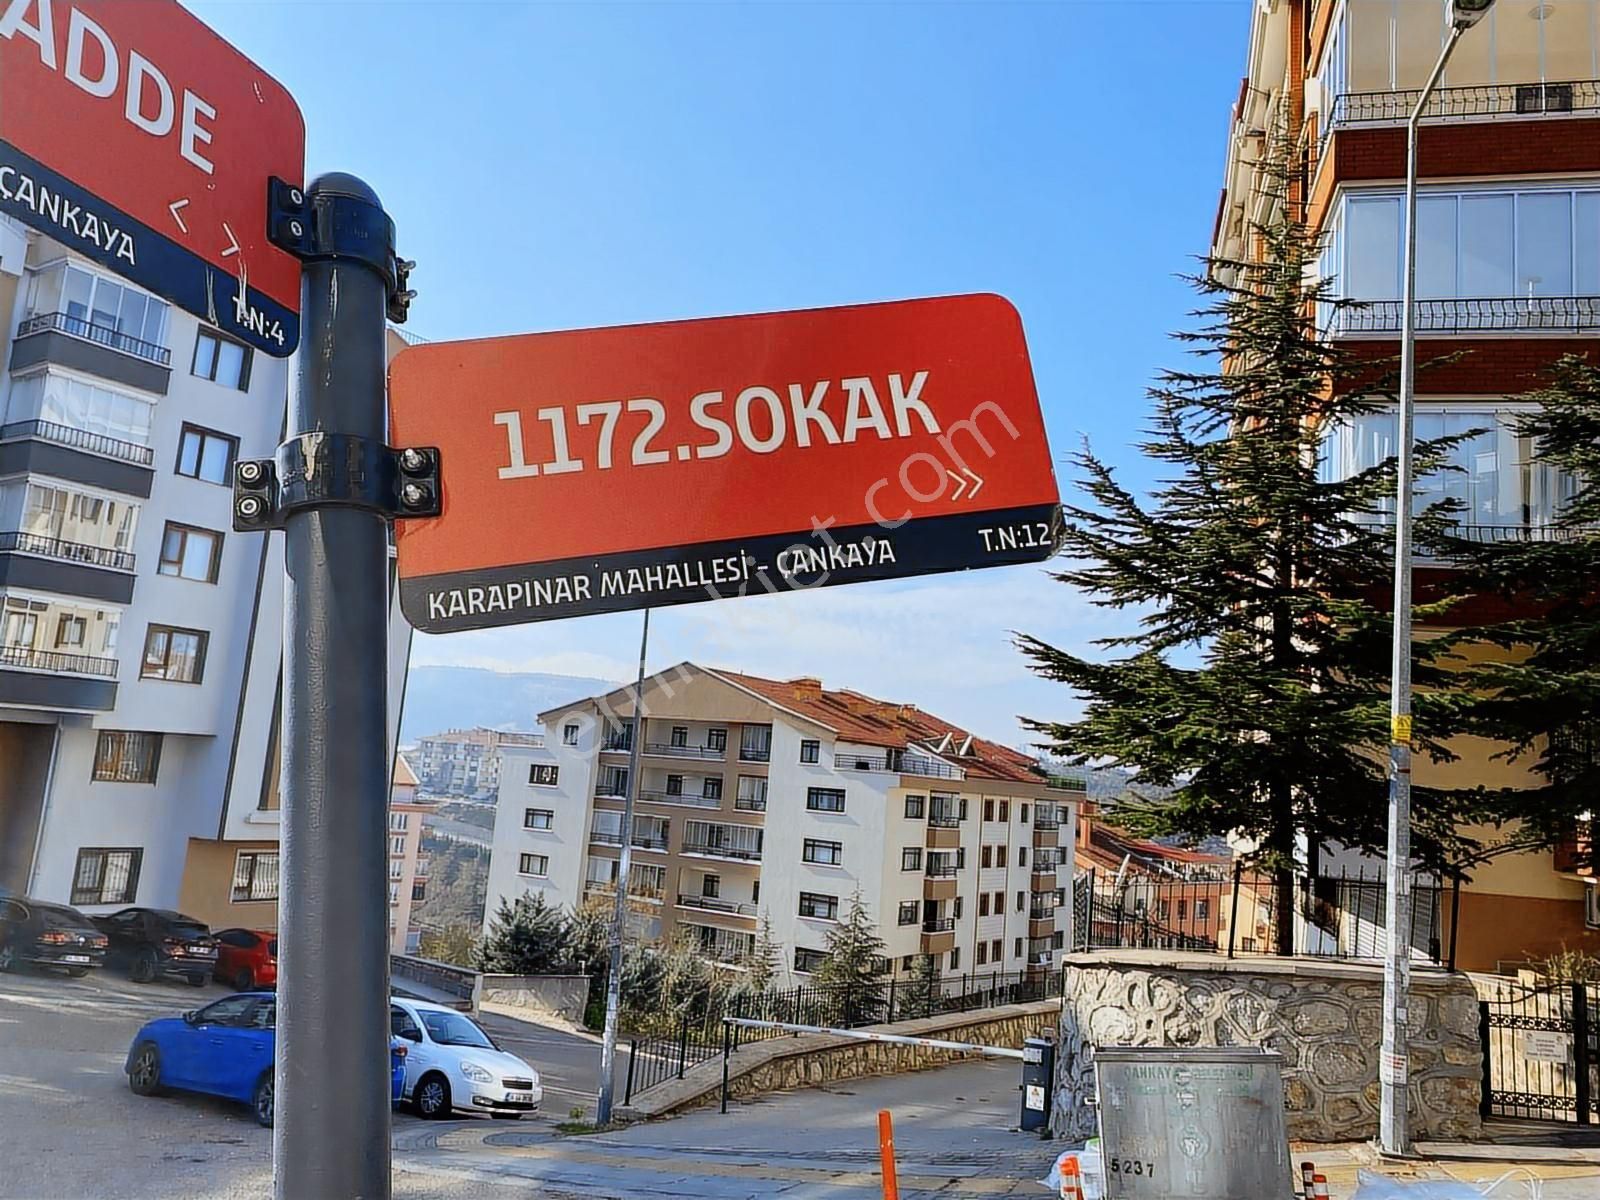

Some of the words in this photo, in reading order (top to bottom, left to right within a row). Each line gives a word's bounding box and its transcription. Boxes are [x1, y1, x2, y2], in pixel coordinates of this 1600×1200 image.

[0, 166, 136, 266] ÇANKAYA
[232, 295, 285, 347] T.N:4
[493, 371, 941, 480] 1172.SOKAK
[977, 523, 1053, 552] T.N:12
[428, 575, 592, 620] KARAPINAR
[600, 549, 750, 598] MAHALLESİ
[776, 538, 897, 579] ÇANKAYA
[1110, 1157, 1154, 1178] 5237
